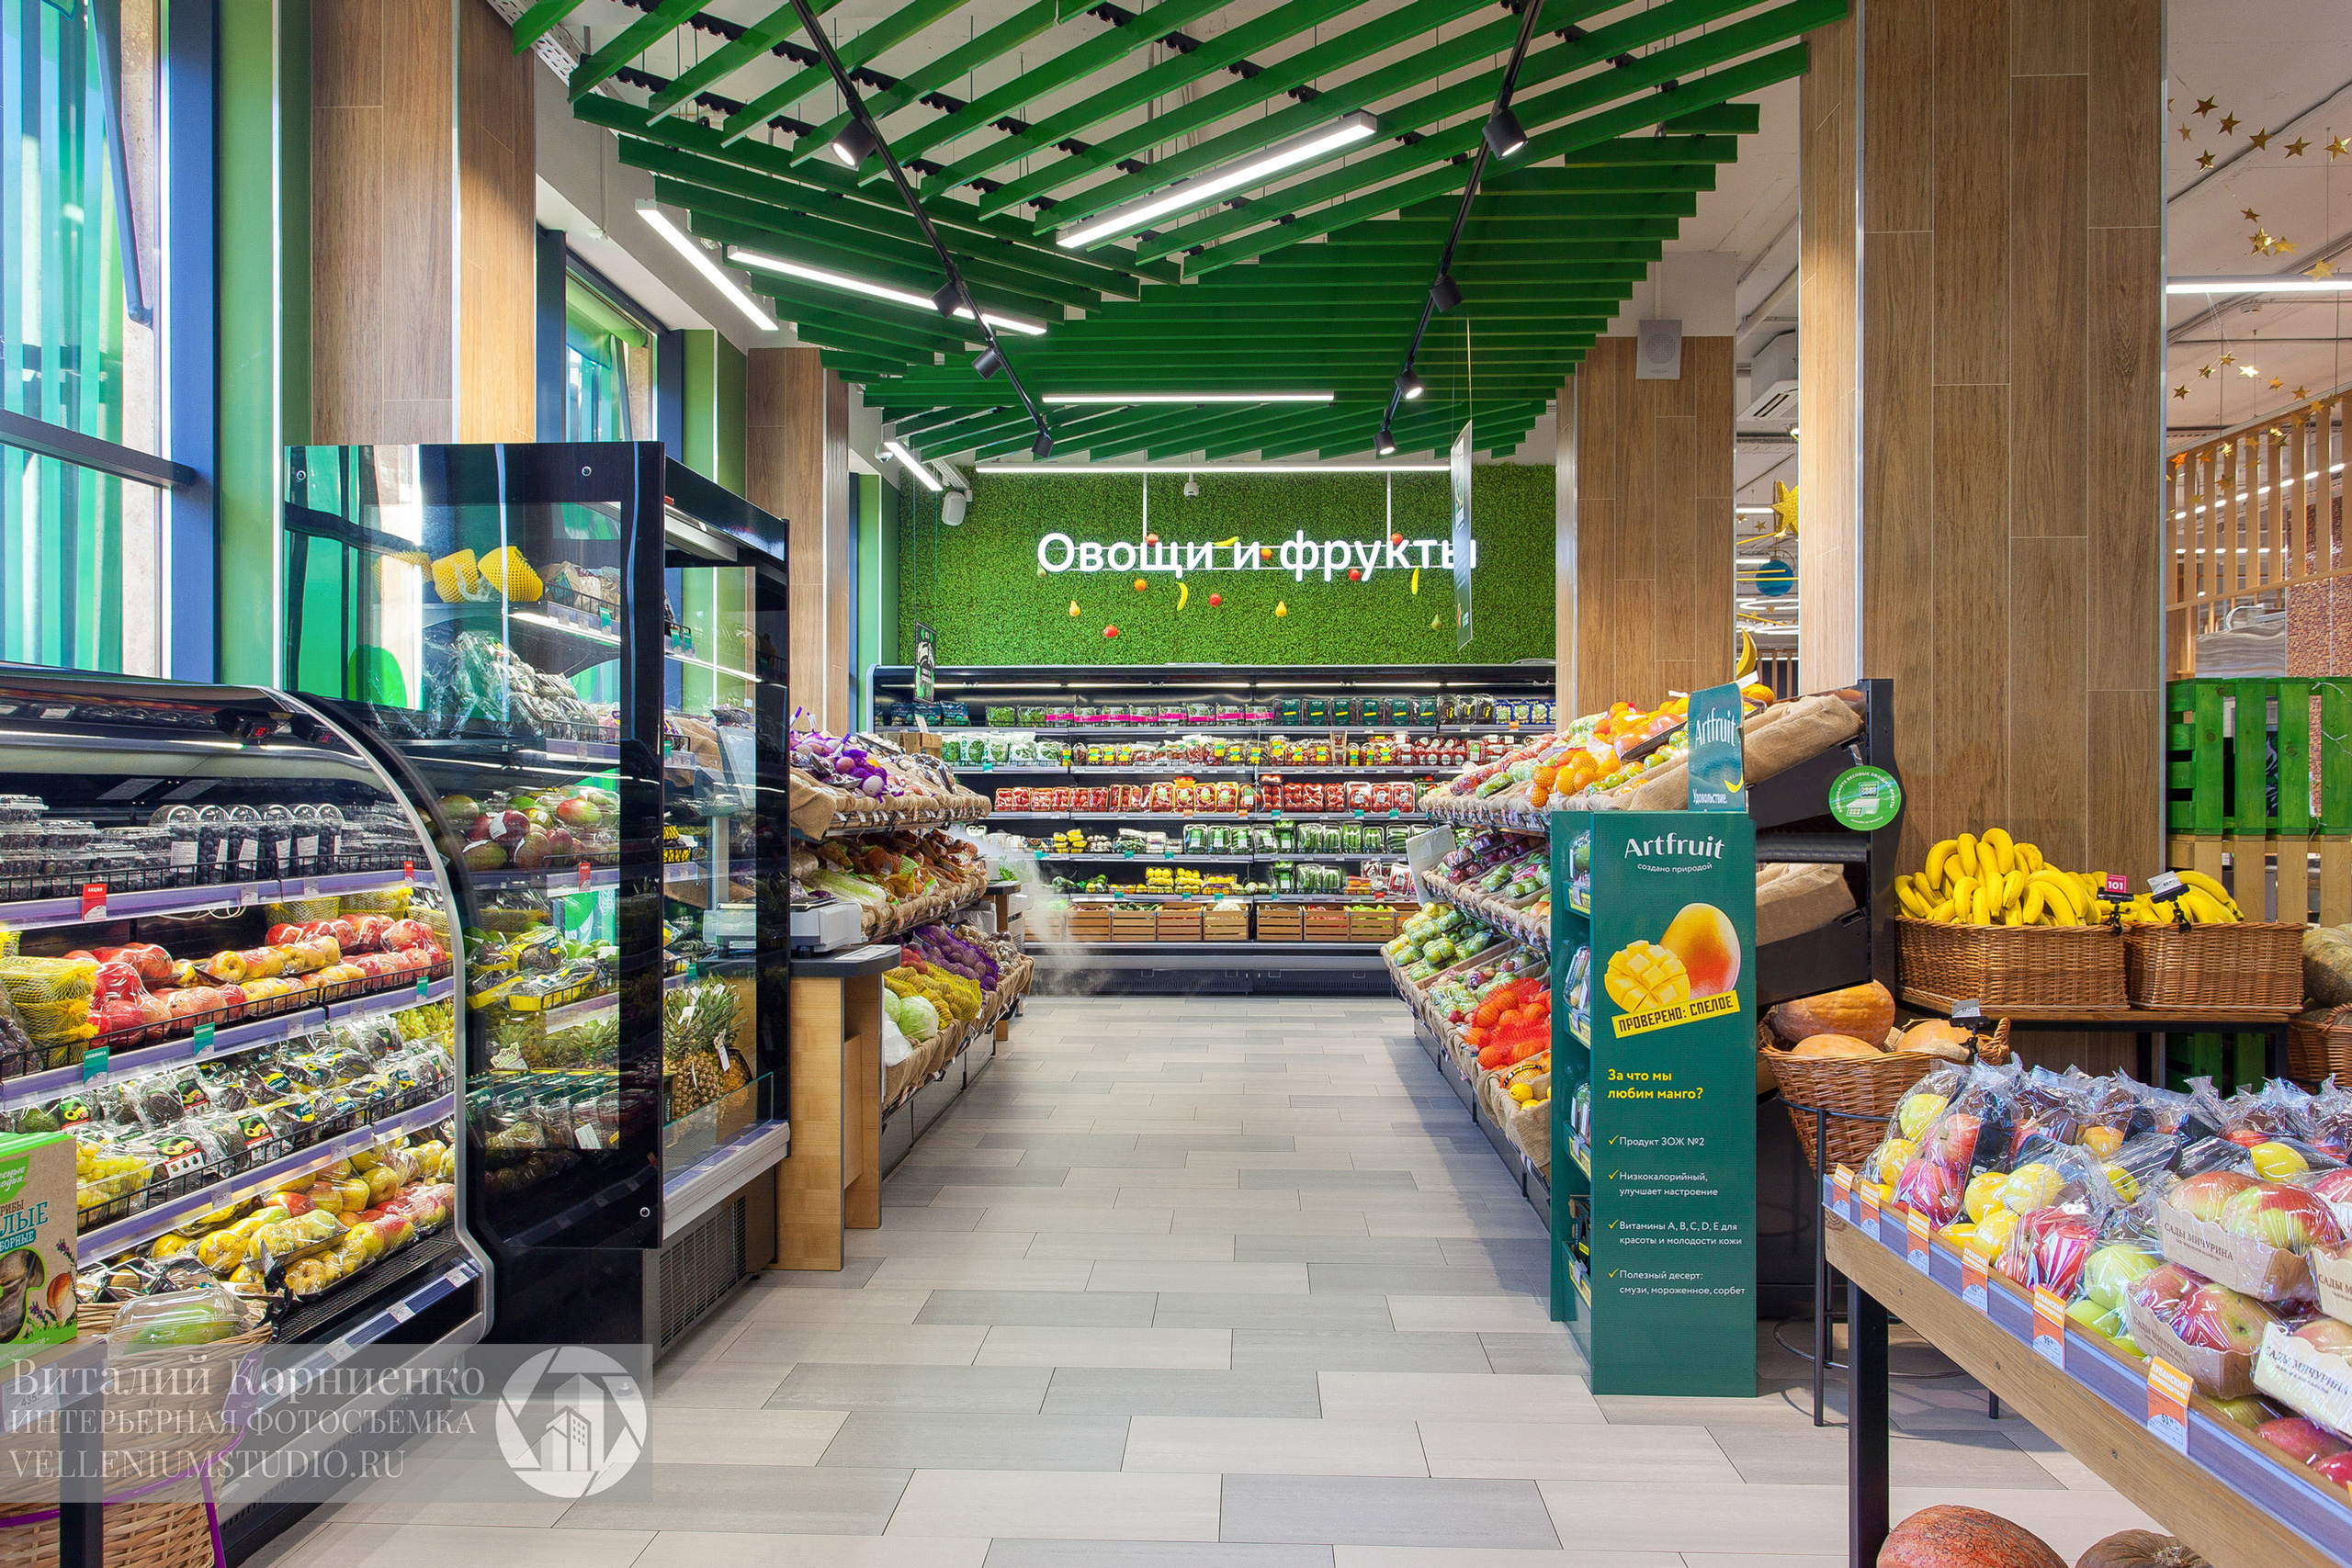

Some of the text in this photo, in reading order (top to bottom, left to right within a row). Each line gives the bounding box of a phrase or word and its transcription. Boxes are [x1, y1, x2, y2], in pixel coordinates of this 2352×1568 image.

[1037, 529, 1477, 582] Овощи и фрукты
[1695, 707, 1736, 750] Artfruit
[1624, 832, 1725, 860] Artfruit
[1637, 862, 1713, 874] создано природой
[2108, 881, 2123, 890] 101
[1618, 995, 1734, 1032] ПРОВЕРЕНО: СПЕЛОЕ
[1608, 1068, 1672, 1081] За что мы
[1608, 1087, 1704, 1100] любим манго?
[1619, 1137, 1705, 1147] Продукт ЗОЖ №2
[1619, 1171, 1709, 1181] Низкокалорийный,
[1619, 1189, 1662, 1197] улучшает
[1619, 1222, 1737, 1232] Витамины A, B, C, D, E для
[1619, 1237, 1657, 1246] красоты
[1667, 1237, 1717, 1246] молодости
[2164, 1223, 2186, 1239] САДЫ
[2187, 1232, 2233, 1261] МИЧУРИНА
[1619, 1269, 1703, 1280] Полезный десерт:
[2318, 1273, 2343, 1292] САДЫ
[1619, 1285, 1746, 1295] смузи, мороженное, сорбет
[2151, 1362, 2188, 1393] КУБАНСКИЙ
